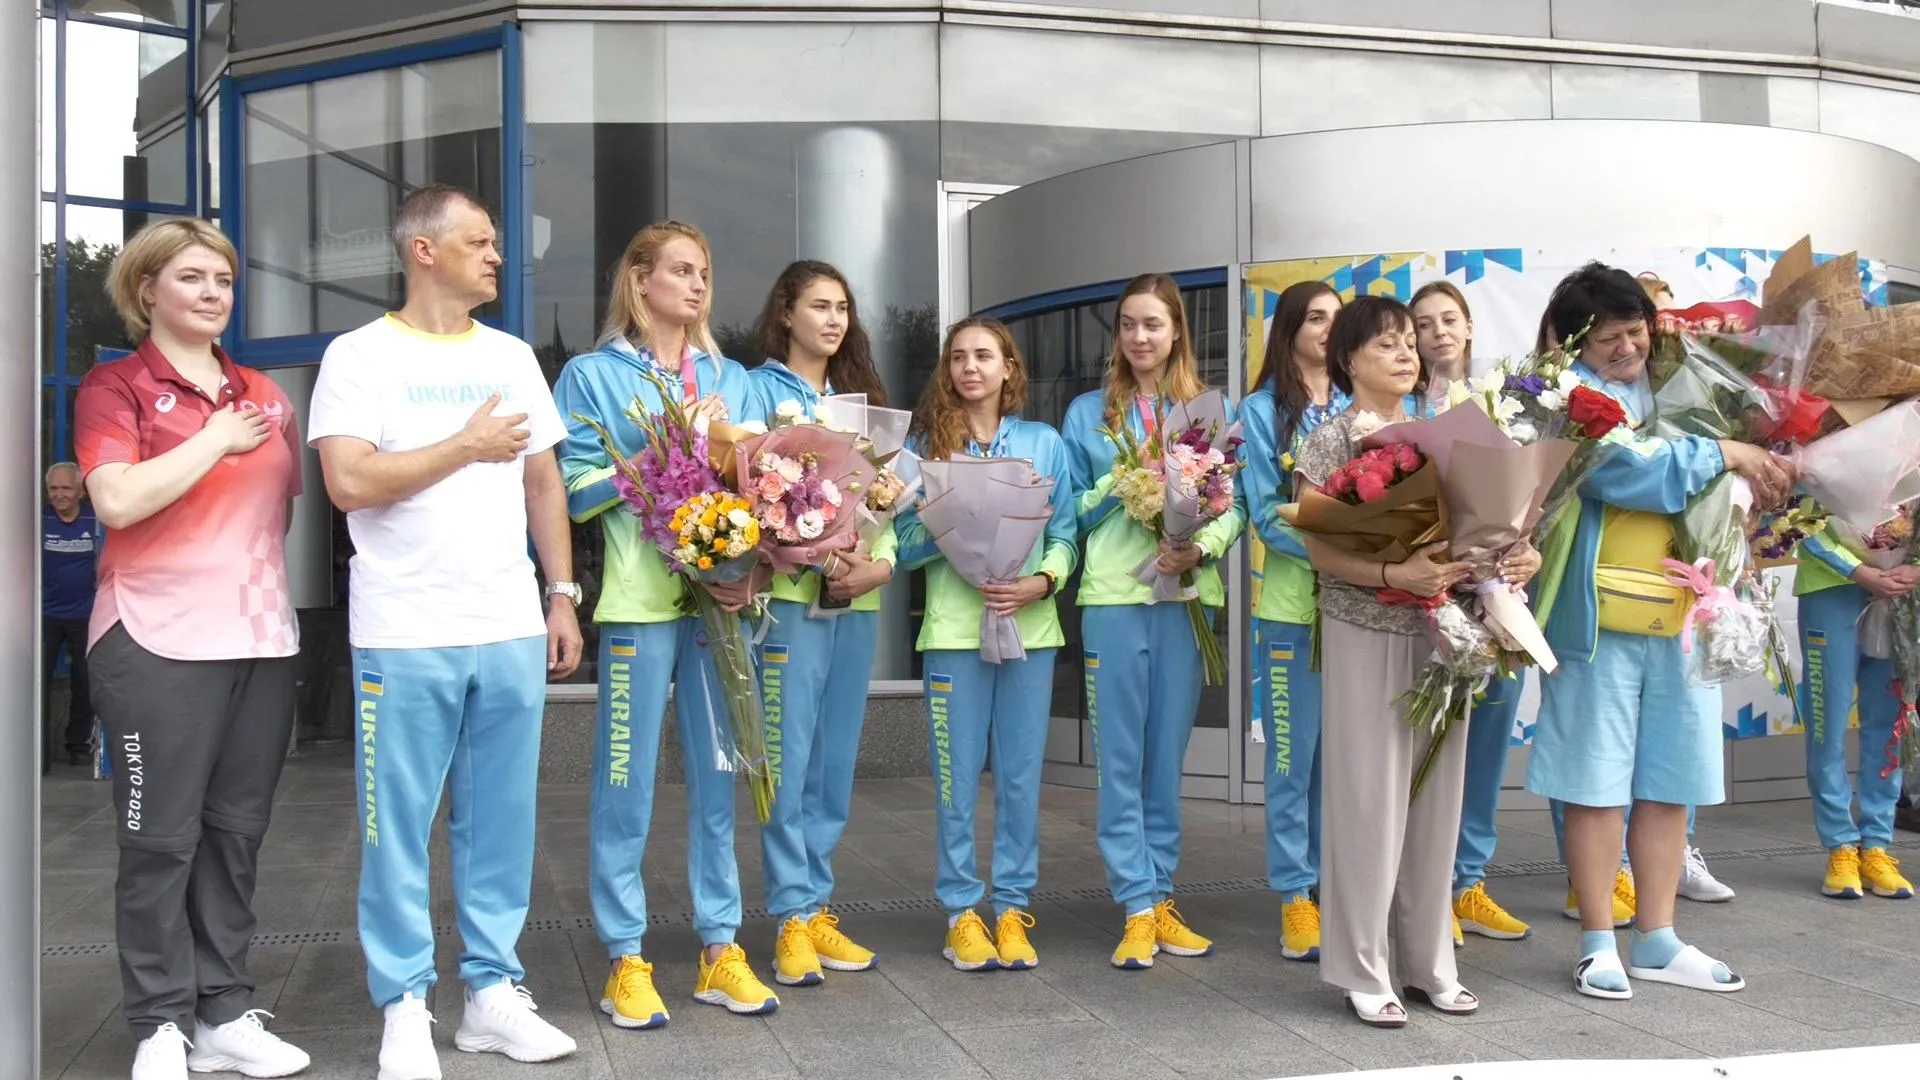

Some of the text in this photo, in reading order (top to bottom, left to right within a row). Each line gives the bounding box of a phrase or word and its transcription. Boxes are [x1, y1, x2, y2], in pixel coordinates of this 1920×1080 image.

[360, 700, 379, 847] UKRAINE
[610, 662, 631, 788] UKRAINE
[931, 696, 952, 809] UKRAINE
[1270, 666, 1291, 777] UKRAINE
[123, 731, 144, 831] TOKYO 2020
